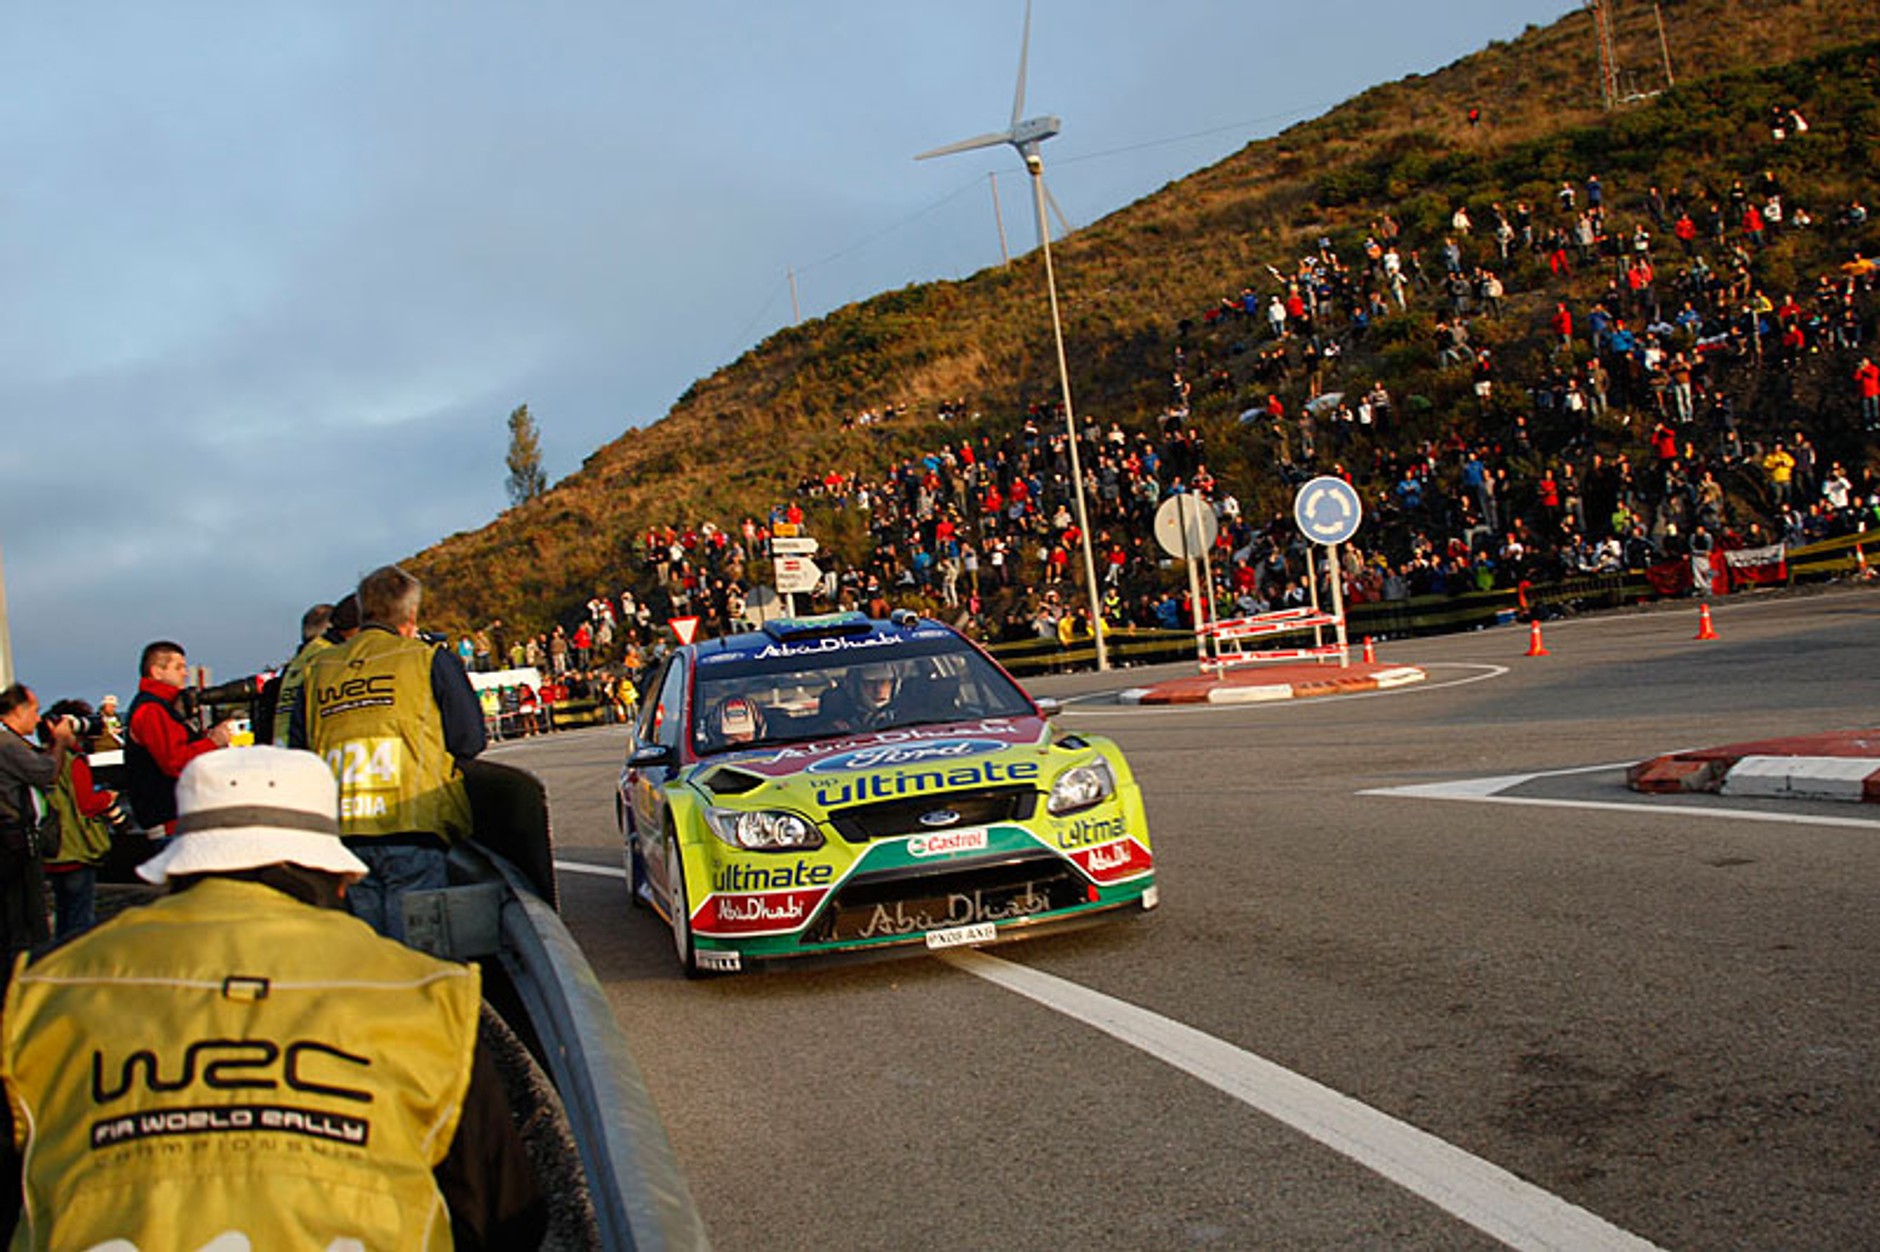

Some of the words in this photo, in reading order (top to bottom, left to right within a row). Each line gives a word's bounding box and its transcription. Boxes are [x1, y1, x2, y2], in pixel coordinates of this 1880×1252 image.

[317, 675, 395, 704] WRC
[846, 742, 974, 768] Ford
[816, 761, 1040, 807] ultimate
[341, 796, 386, 818] EDIA
[928, 832, 982, 852] Castrol
[713, 860, 833, 891] ultimate
[93, 1039, 374, 1105] WRC
[95, 1119, 134, 1143] FIA
[141, 1110, 253, 1132] WORLD
[261, 1109, 364, 1142] RALLY
